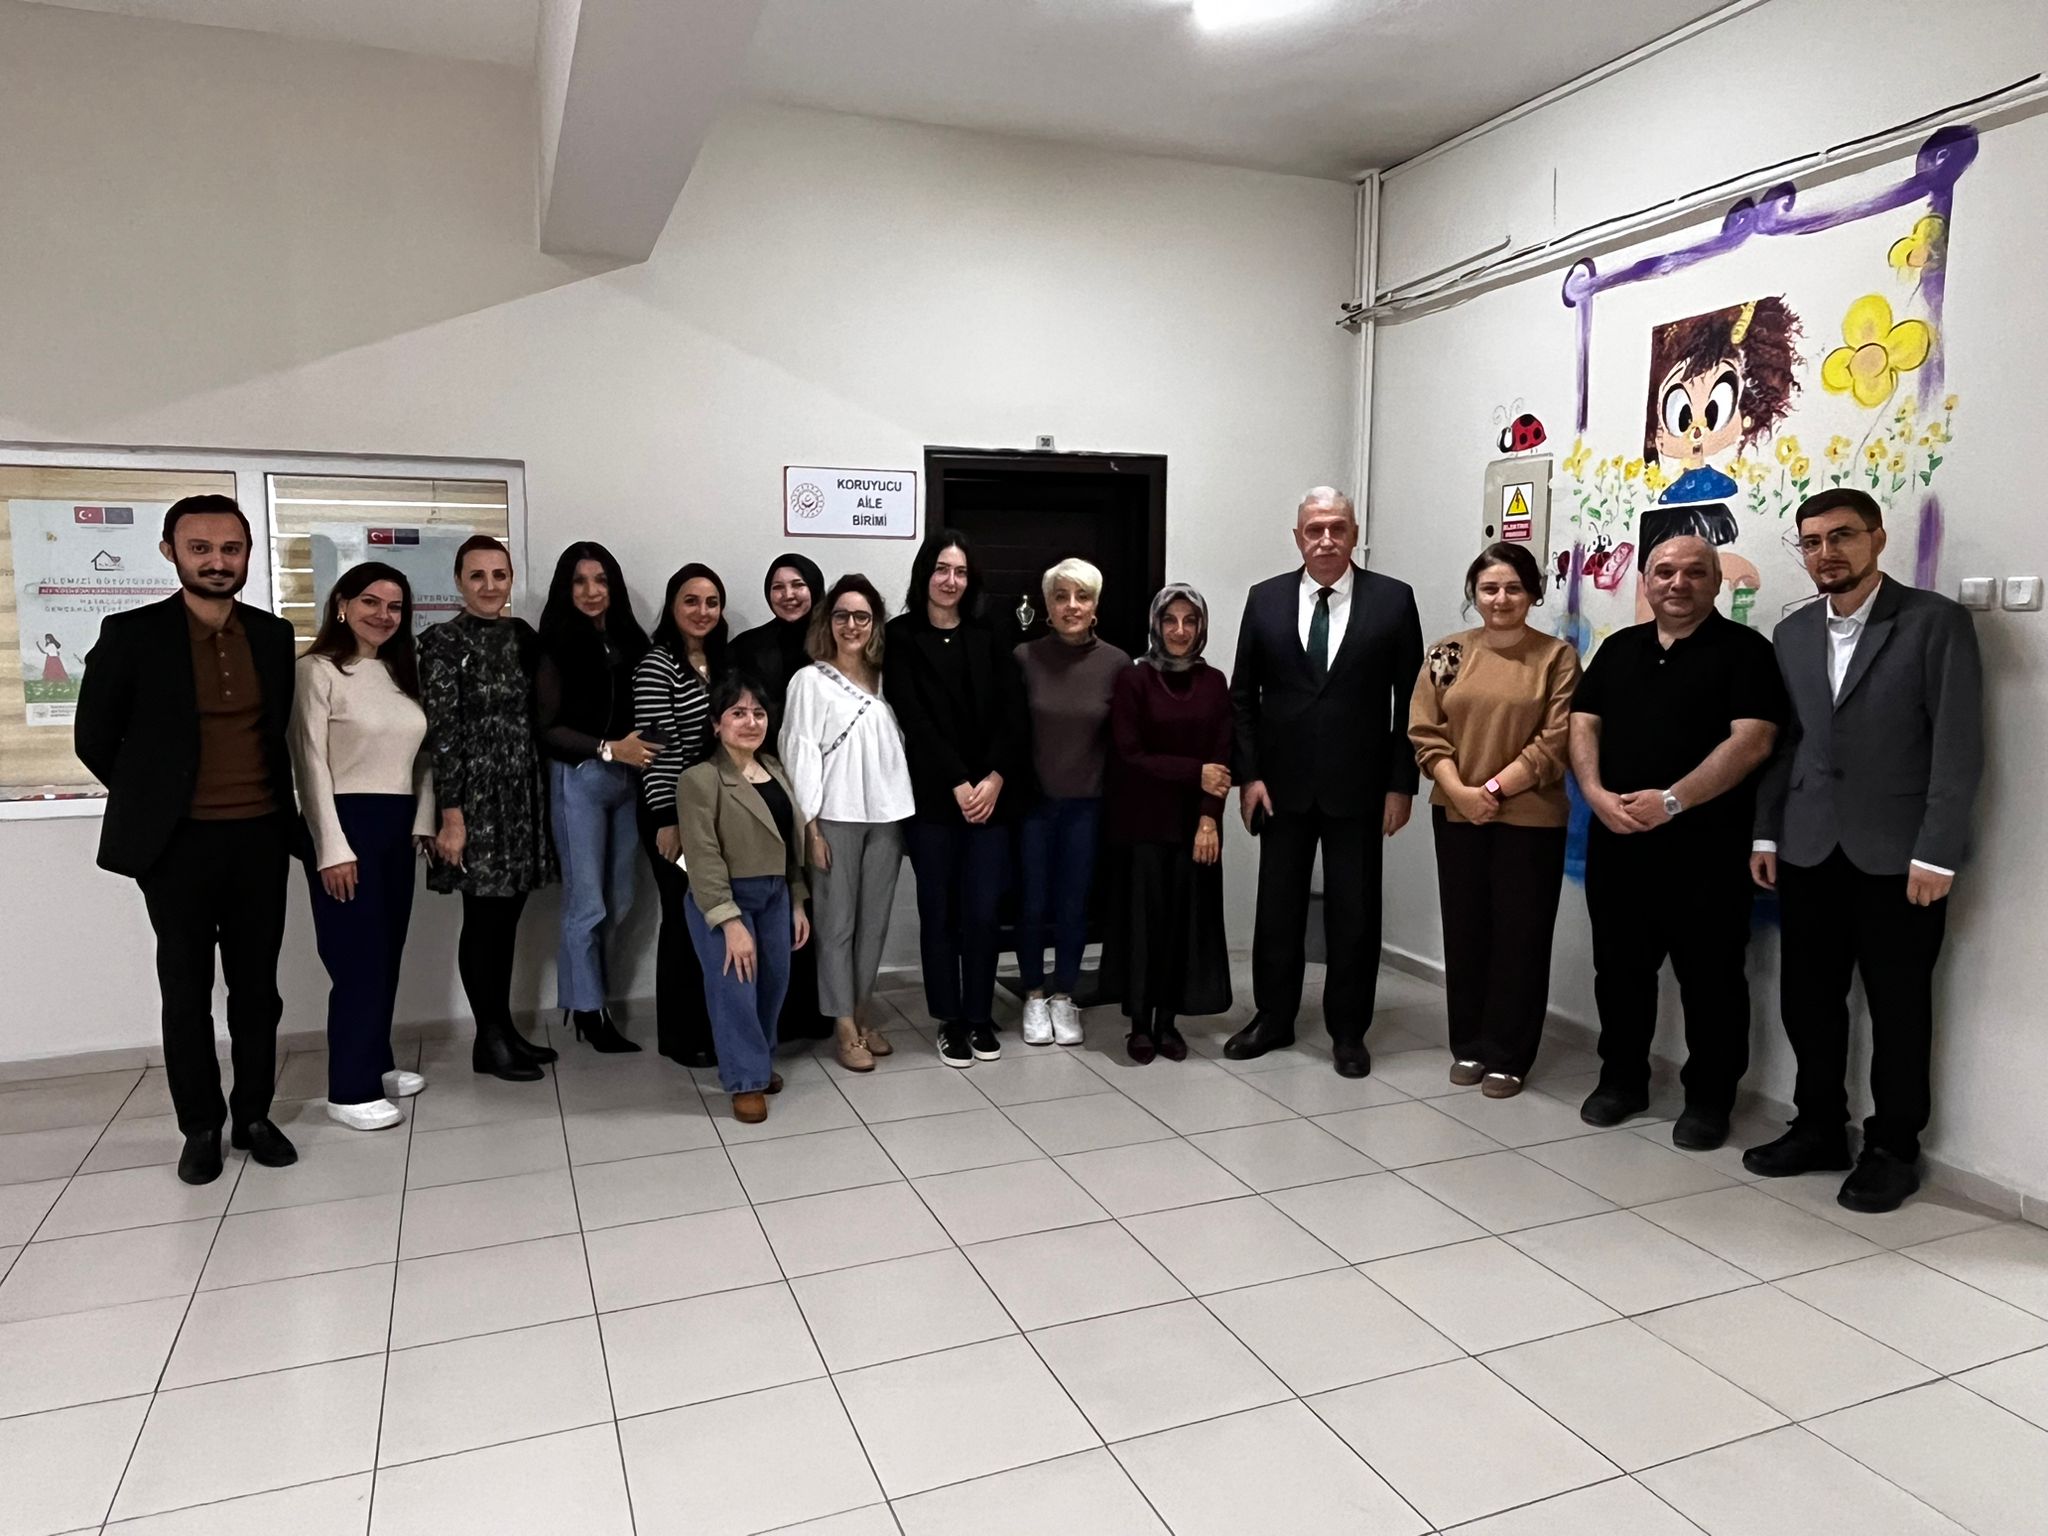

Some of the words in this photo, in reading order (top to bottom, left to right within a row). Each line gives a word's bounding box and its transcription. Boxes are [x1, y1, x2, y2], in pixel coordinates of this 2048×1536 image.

[837, 478, 902, 492] KORUYUCU
[856, 494, 883, 509] AİLE
[852, 514, 887, 527] BİRİMİ
